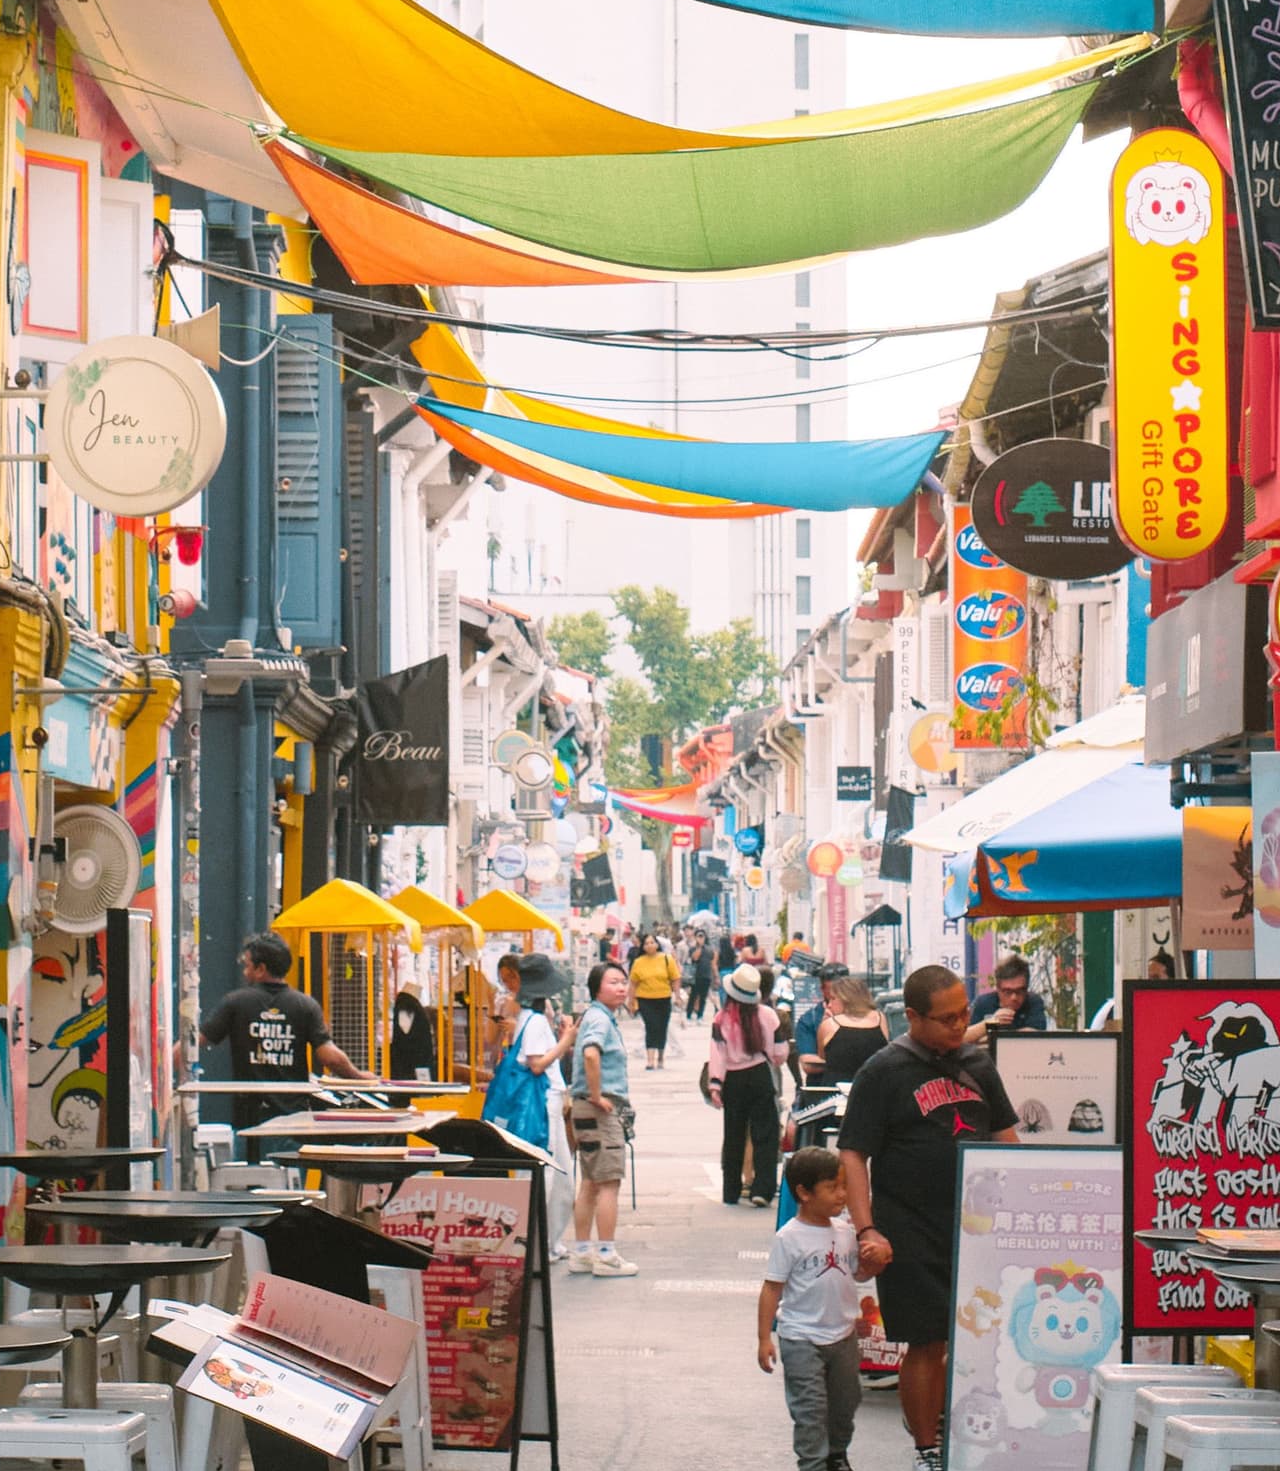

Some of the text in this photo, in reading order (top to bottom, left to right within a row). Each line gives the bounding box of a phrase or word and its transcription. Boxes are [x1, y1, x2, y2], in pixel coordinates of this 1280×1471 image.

[85, 389, 139, 451] Jen
[113, 434, 180, 445] BEAUTY
[1142, 420, 1163, 541] Gift Gate
[363, 730, 441, 761] Beau
[941, 955, 961, 970] 36
[250, 1022, 296, 1039] CHILL
[441, 1191, 518, 1225] Hours
[442, 1220, 502, 1243] pizza
[996, 1238, 1104, 1250] MERLION WITH
